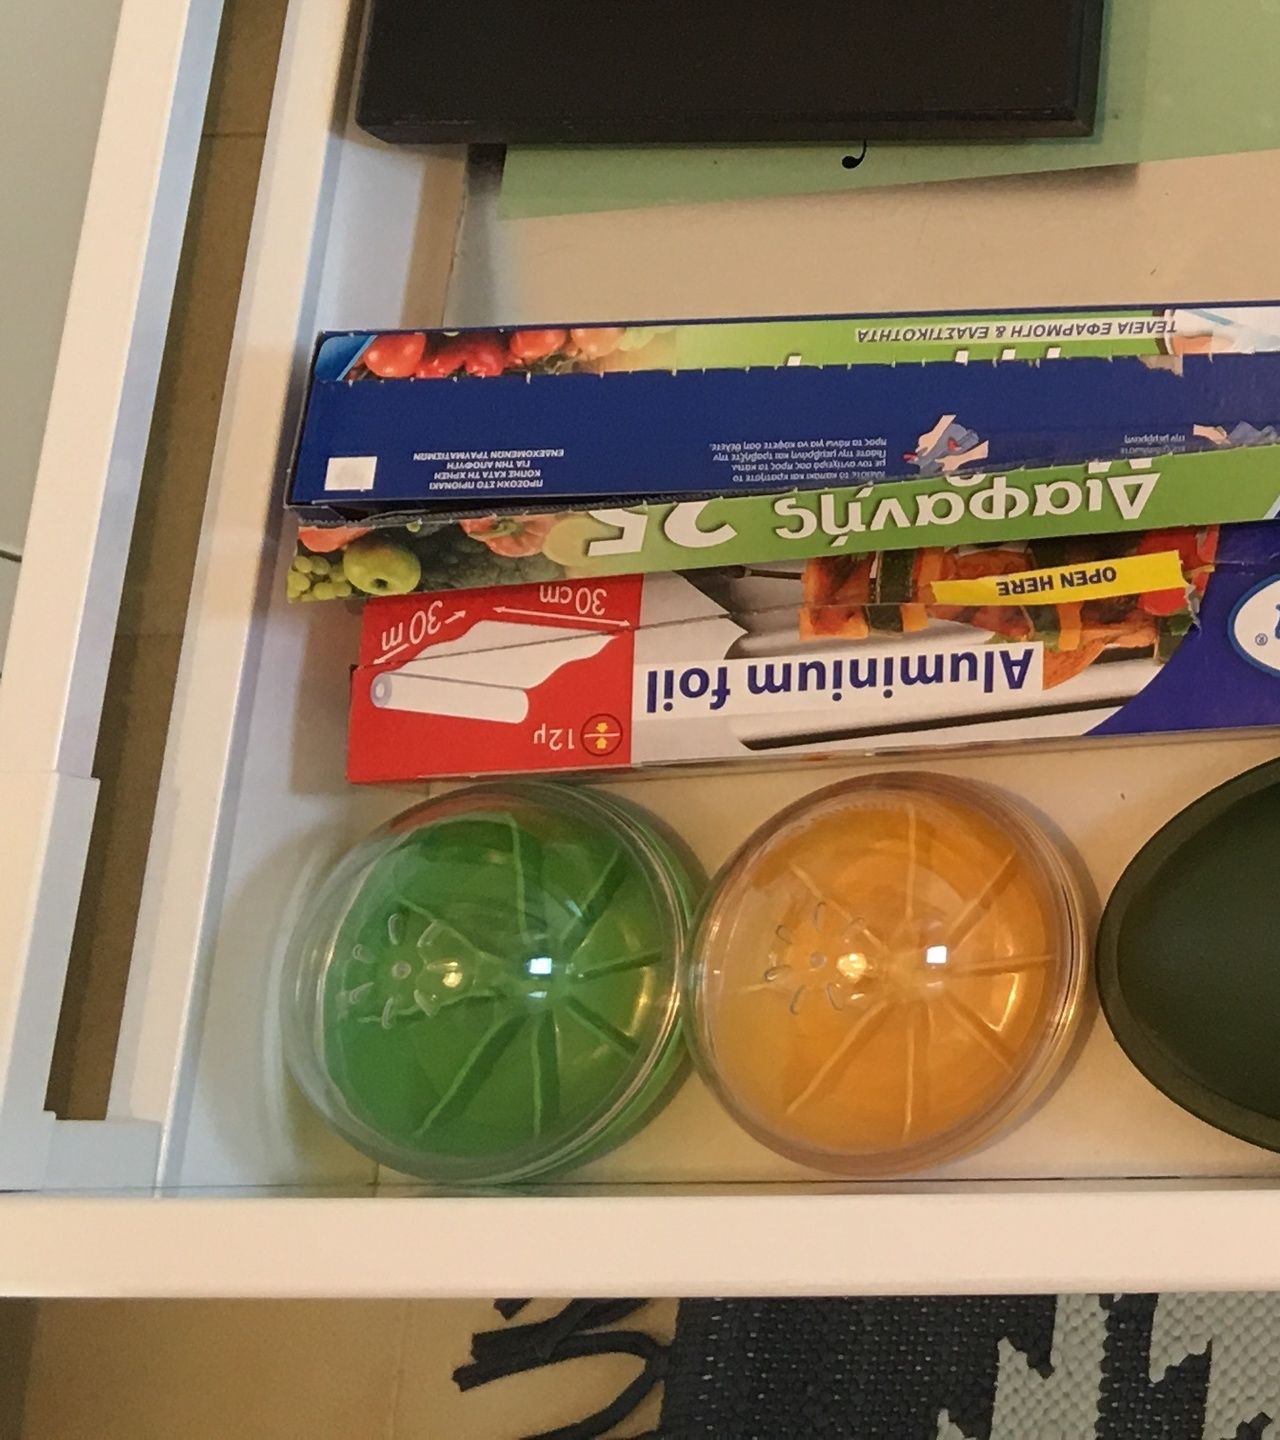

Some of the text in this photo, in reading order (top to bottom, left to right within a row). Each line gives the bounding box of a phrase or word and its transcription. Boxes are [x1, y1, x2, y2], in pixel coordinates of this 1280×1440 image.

[857, 320, 1177, 343] ΤΕΛΕΙΑ ΕΦΑΡΜΟΓΗ & ΕΛΑΣΤΙΚΟΤΗΤΑ
[773, 472, 1160, 547] Διαφανής
[996, 566, 1117, 596] OPEN HERE
[576, 587, 607, 615] 30
[646, 648, 1034, 713] Aluminium foil
